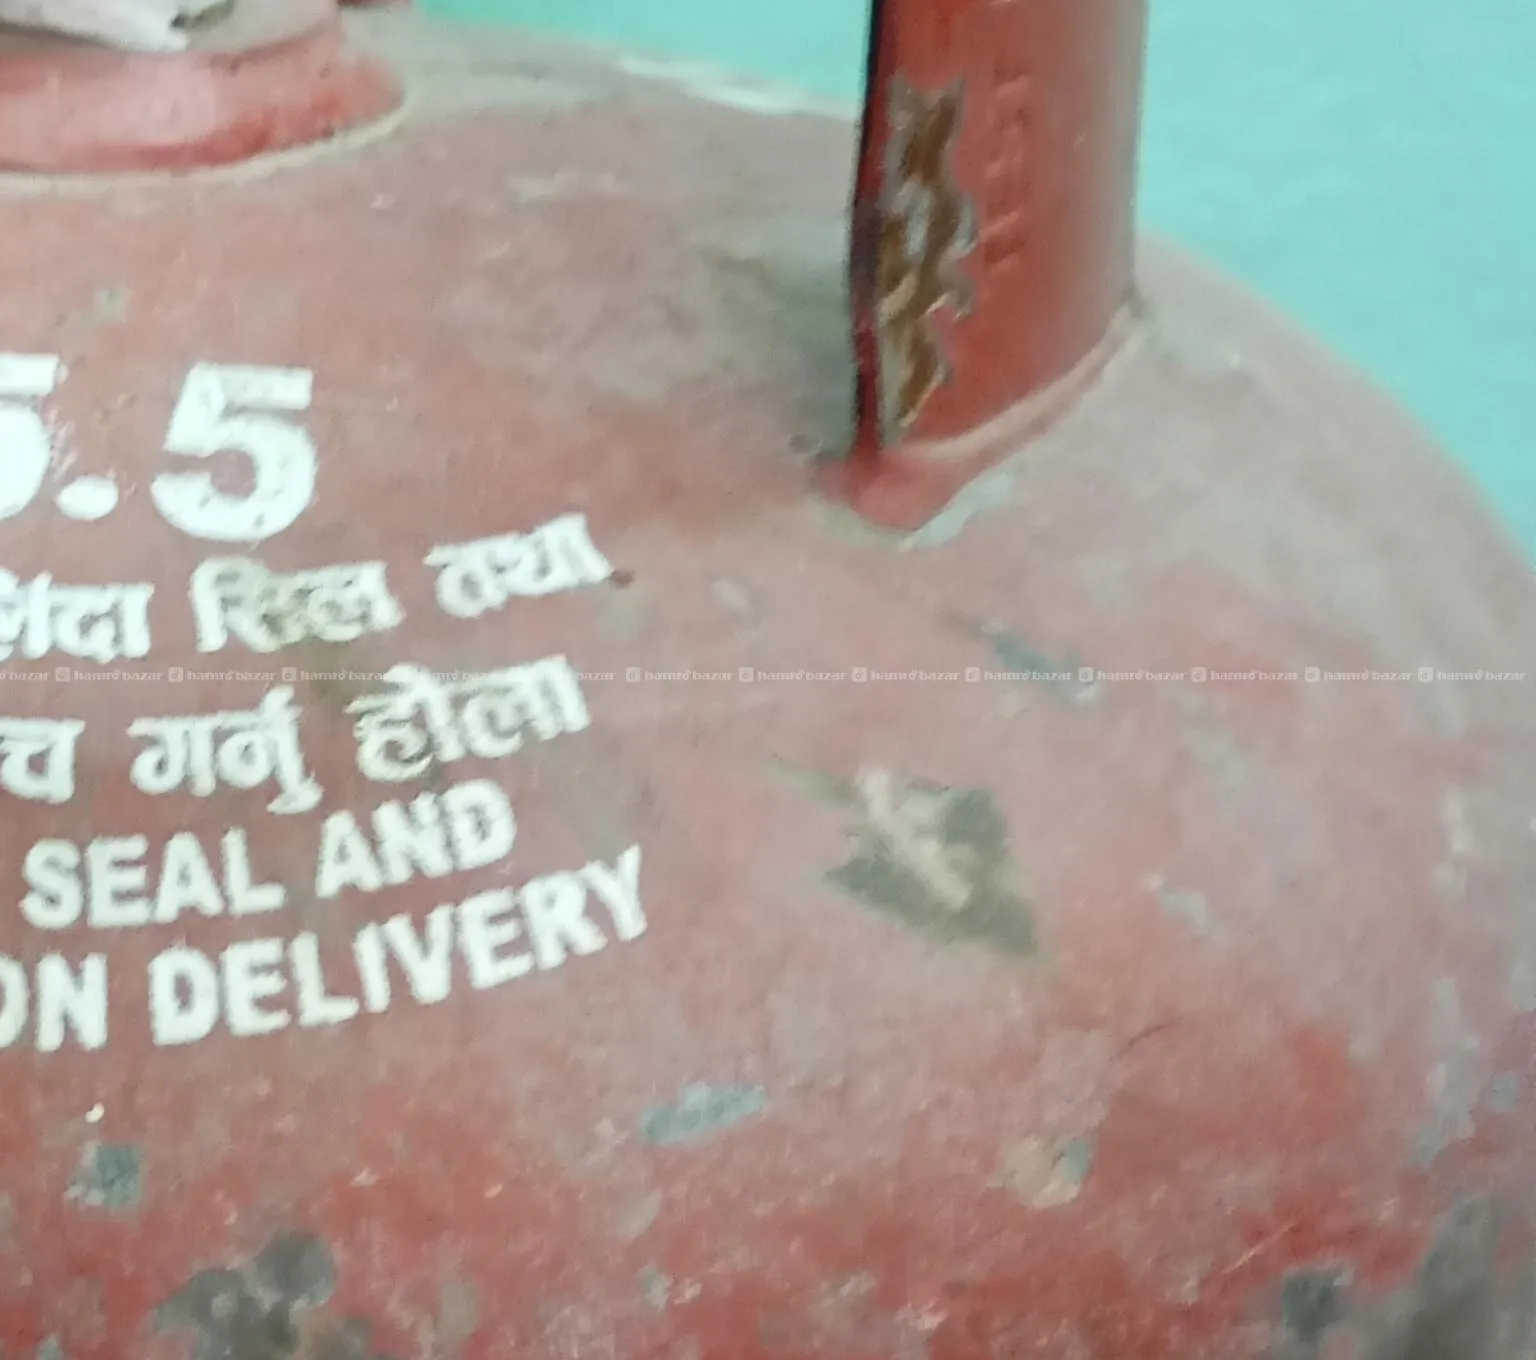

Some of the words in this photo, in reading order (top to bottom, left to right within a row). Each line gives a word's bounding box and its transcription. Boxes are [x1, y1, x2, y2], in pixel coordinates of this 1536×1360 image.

[20, 827, 286, 930] SEAL
[315, 779, 517, 899] AND
[148, 844, 648, 1046] DELIVERY
